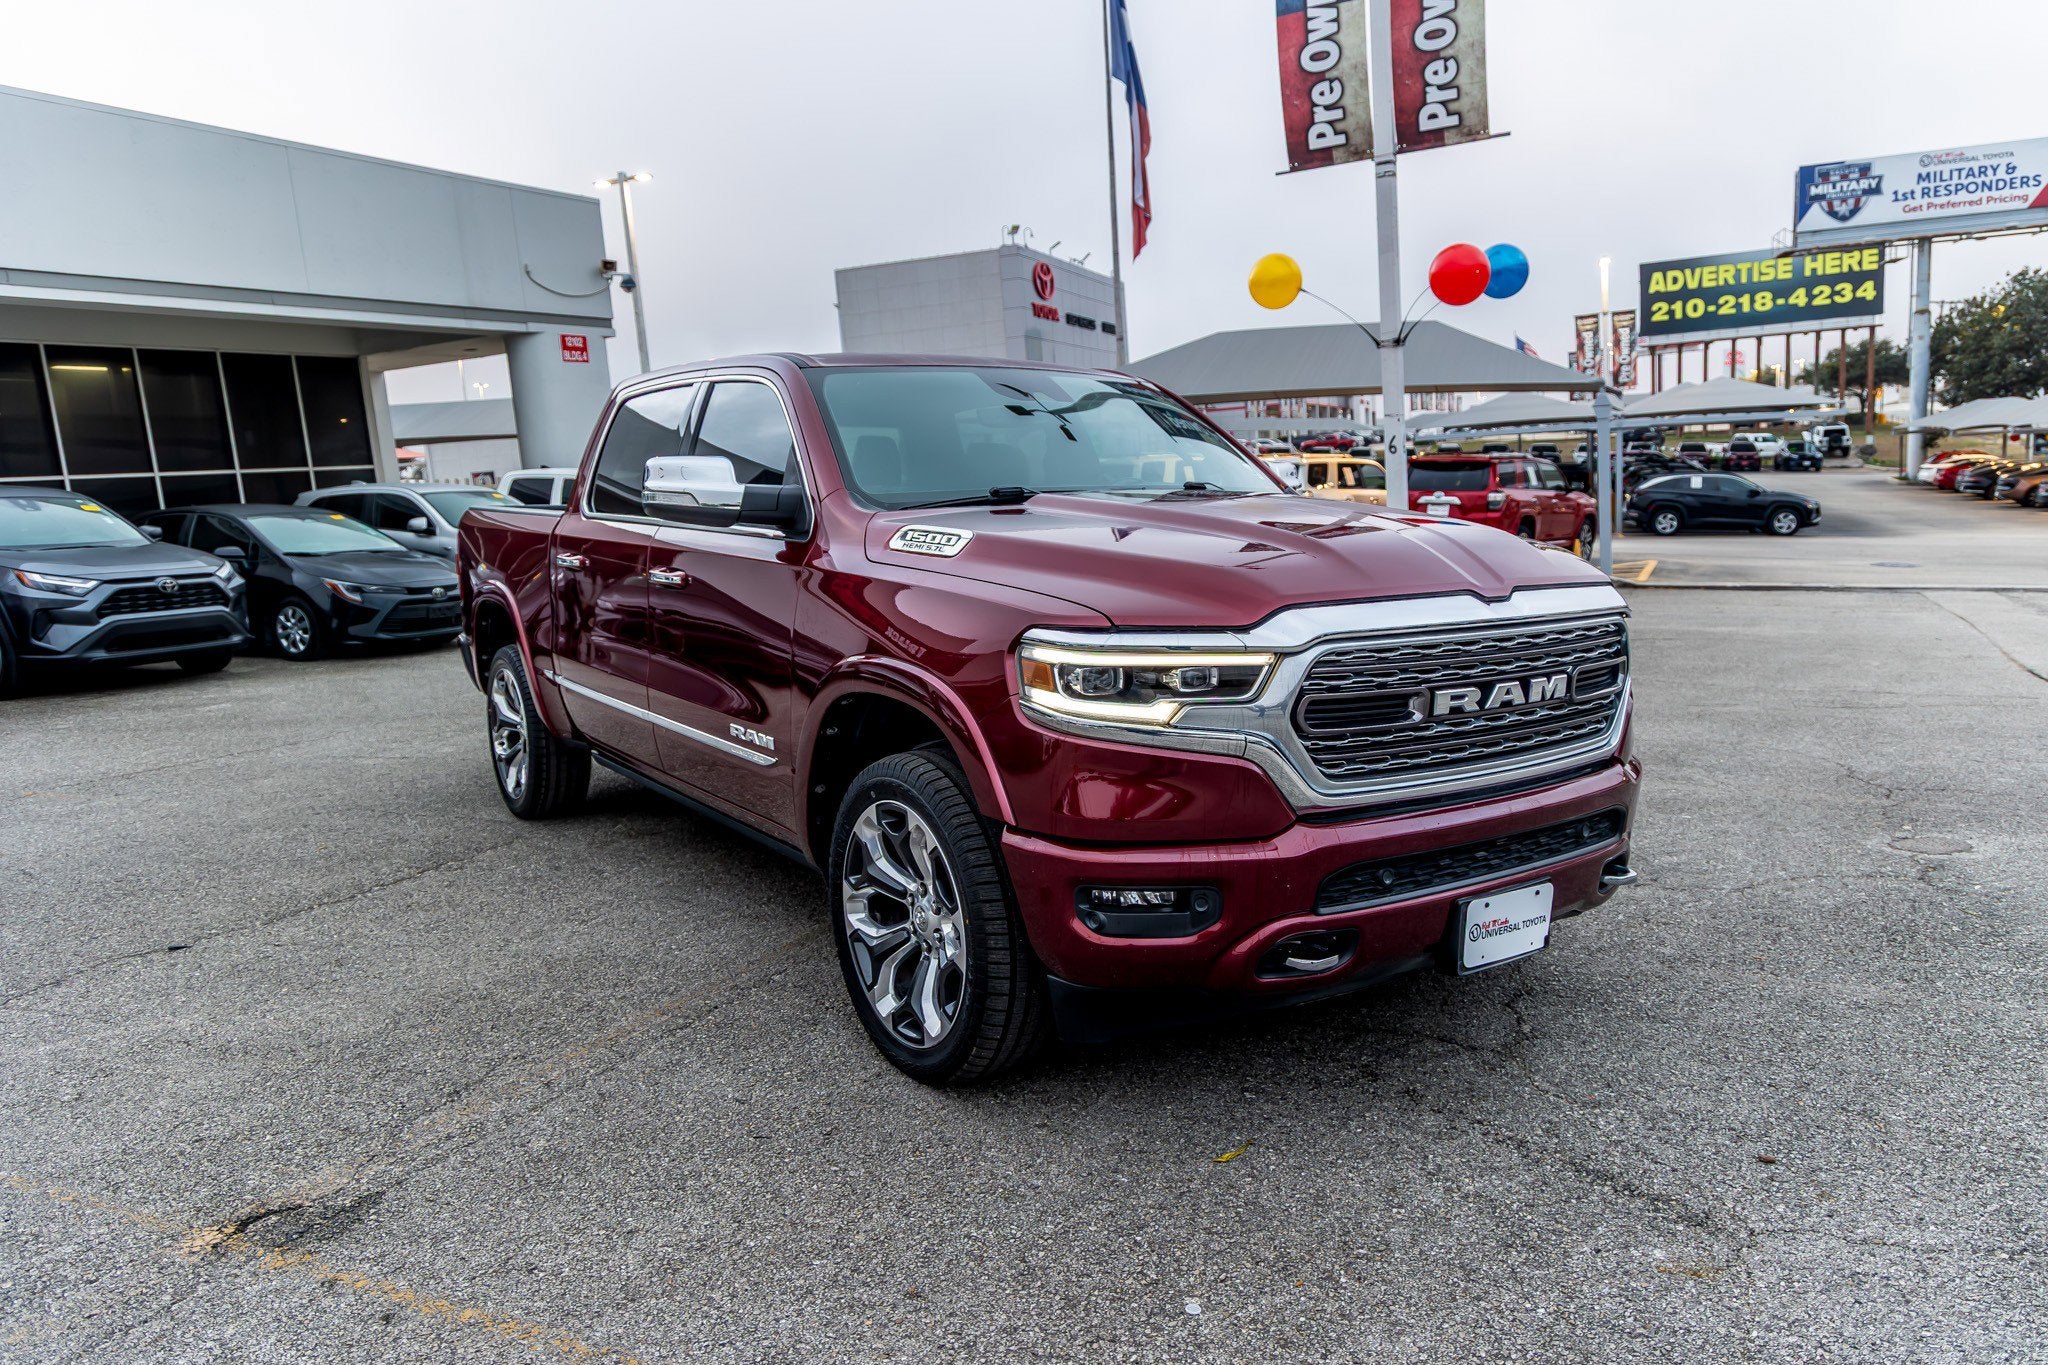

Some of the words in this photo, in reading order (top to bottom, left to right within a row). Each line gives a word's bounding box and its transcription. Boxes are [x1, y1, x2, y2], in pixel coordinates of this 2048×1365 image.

[1299, 0, 1341, 73] Ow
[1418, 57, 1460, 132] Pre
[1307, 78, 1348, 150] Pre
[1982, 151, 2015, 161] TOYOTA
[1809, 176, 1880, 197] MILITARY
[1916, 163, 2001, 185] MILITARY
[2005, 162, 2018, 175] &
[1891, 189, 1916, 203] 1st
[1921, 174, 2042, 199] RESPONDERS
[1902, 203, 1923, 214] Get
[1926, 196, 1983, 211] Preferred
[1986, 193, 2029, 205] Pricing
[1648, 257, 1793, 294] ADVERTISE
[1803, 248, 1880, 278] HERE
[1650, 280, 1878, 323] 210-218-4234
[1388, 434, 1398, 455] 6
[901, 542, 925, 551] HEMI
[925, 545, 946, 553] 5.7L
[903, 529, 960, 546] 1500
[1433, 674, 1568, 717] RAM
[729, 722, 775, 751] RAM
[1481, 923, 1521, 940] UNIVERSAL
[1522, 915, 1547, 929] TOYOTA
